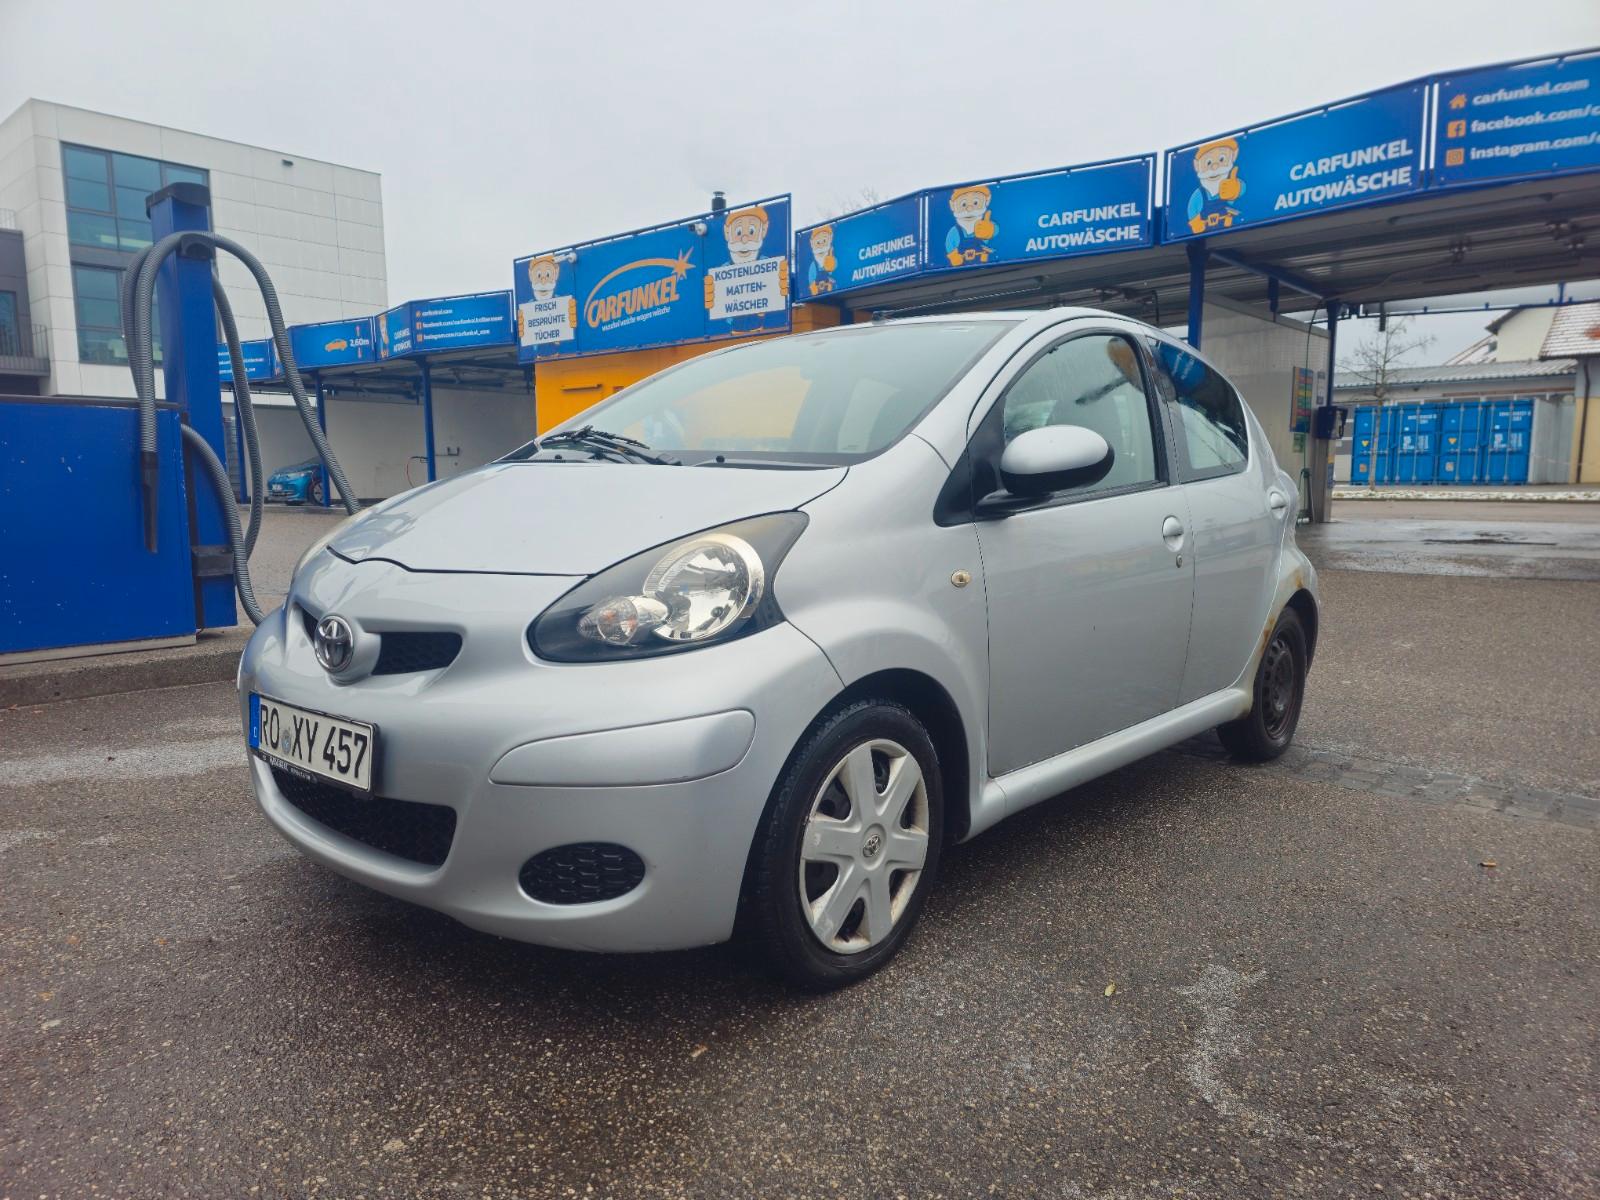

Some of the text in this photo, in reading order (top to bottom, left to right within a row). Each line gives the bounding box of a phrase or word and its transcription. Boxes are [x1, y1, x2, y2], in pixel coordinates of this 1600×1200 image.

[1472, 79, 1590, 105] carfunkel.com
[1290, 139, 1413, 181] CARFUNKEL
[1274, 166, 1411, 211] AUTOWÄSCHE
[1038, 202, 1141, 228] CARFUNKEL
[858, 234, 917, 260] CARFUNKEL
[1025, 224, 1141, 252] AUTOWÄSCHE
[714, 261, 778, 281] KOSTENLOSER
[851, 254, 917, 282] AUTOWÄSCHE
[587, 274, 680, 328] CARFUNKEL
[726, 281, 767, 296] MATTEN-
[534, 301, 557, 312] FRISCH
[725, 298, 769, 313] WÄSCHER
[534, 329, 560, 341] TÜCHER
[260, 703, 280, 750] RO
[291, 714, 319, 763] XY
[322, 726, 368, 779] 457
